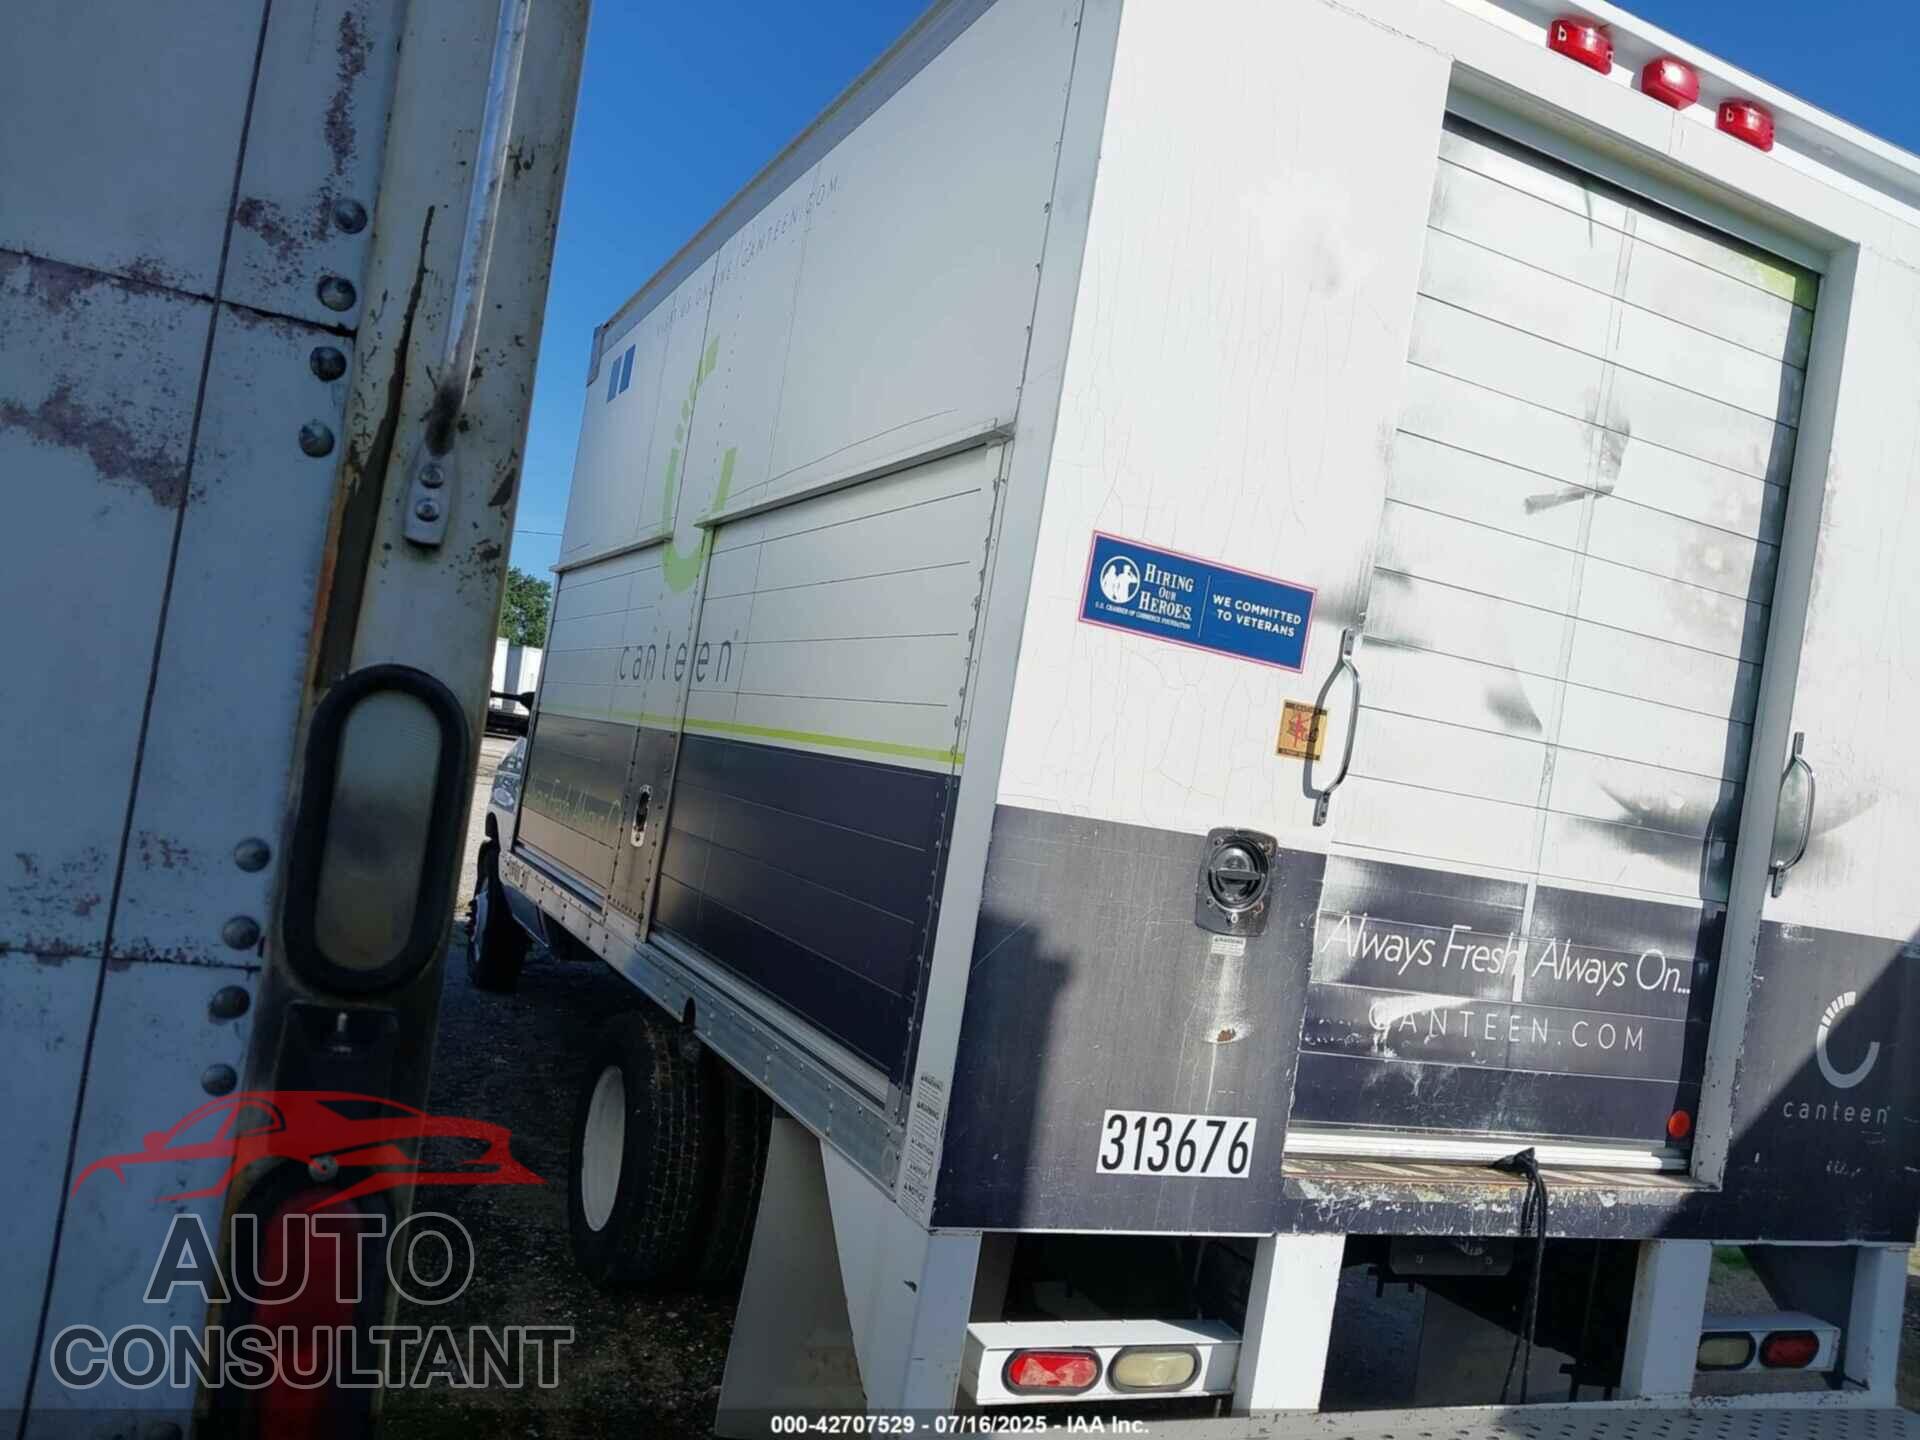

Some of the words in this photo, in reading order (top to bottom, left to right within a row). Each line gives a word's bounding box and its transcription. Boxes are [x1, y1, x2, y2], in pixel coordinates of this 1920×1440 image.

[1143, 562, 1195, 593] HIRING
[1138, 590, 1193, 621] HEROES
[1158, 586, 1177, 602] OUR
[1212, 593, 1232, 608] WE
[1235, 599, 1302, 625] COMMITTED
[1216, 608, 1232, 622] TO
[1235, 615, 1296, 638] VETERANS
[619, 630, 733, 683] canteen
[1321, 910, 1434, 976] Always
[1441, 923, 1521, 977] Fresh
[1531, 936, 1629, 996] Always
[1368, 1003, 1645, 1053] CANTEEN.COM
[1783, 1099, 1890, 1125] canteen
[1101, 1113, 1251, 1175] 313676
